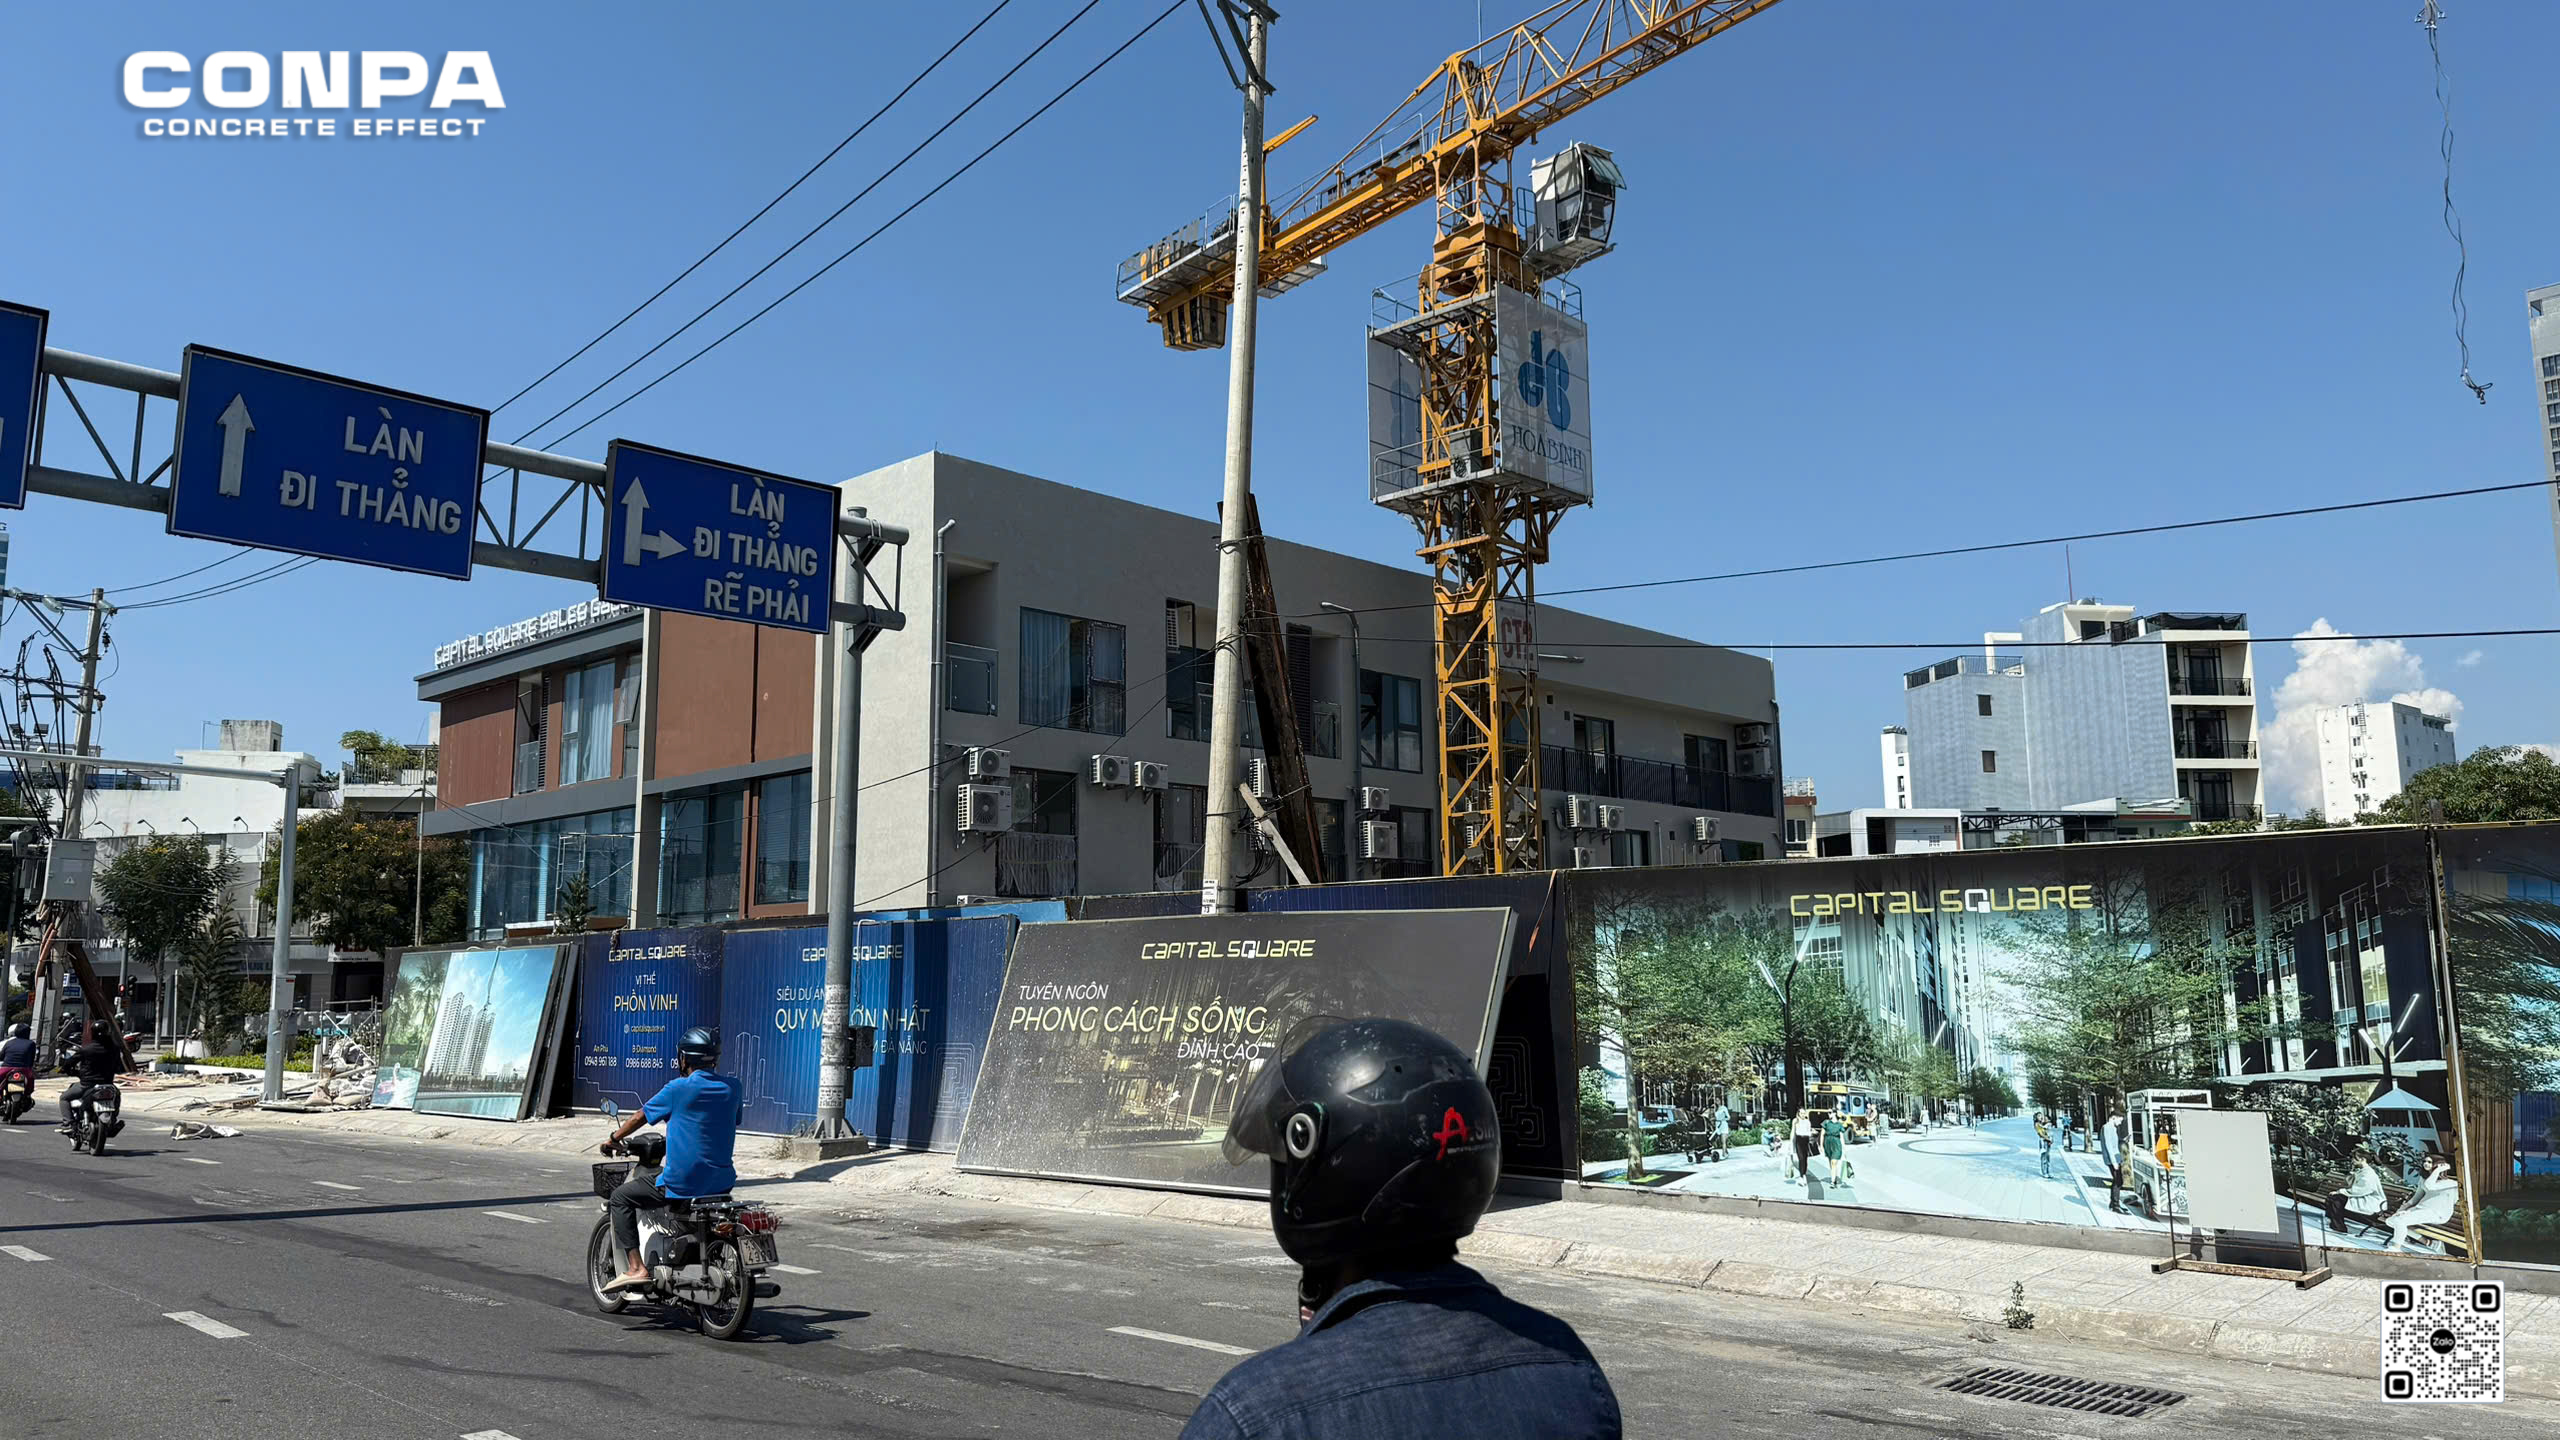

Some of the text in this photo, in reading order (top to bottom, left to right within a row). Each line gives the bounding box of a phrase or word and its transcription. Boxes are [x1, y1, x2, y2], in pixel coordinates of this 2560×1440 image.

[344, 406, 424, 465] LÀN
[280, 467, 463, 535] ĐI THẲNG
[730, 476, 785, 523] LÀN
[693, 520, 818, 577] ĐI THẲNG
[704, 571, 809, 624] RẼ PHẢI
[1790, 885, 2095, 917] CAPITAL SQUARE
[1141, 939, 1317, 960] CAPITAL SQUARE
[649, 993, 678, 1012] VINH
[776, 985, 797, 1001] SIÊU
[1019, 981, 1109, 1000] TUYÊN NGÔN
[775, 1008, 809, 1033] QUY
[882, 1000, 930, 1031] NHẤT
[1008, 995, 1268, 1034] PHONG CÁCH SỐNG
[1223, 1042, 1260, 1060] CAO
